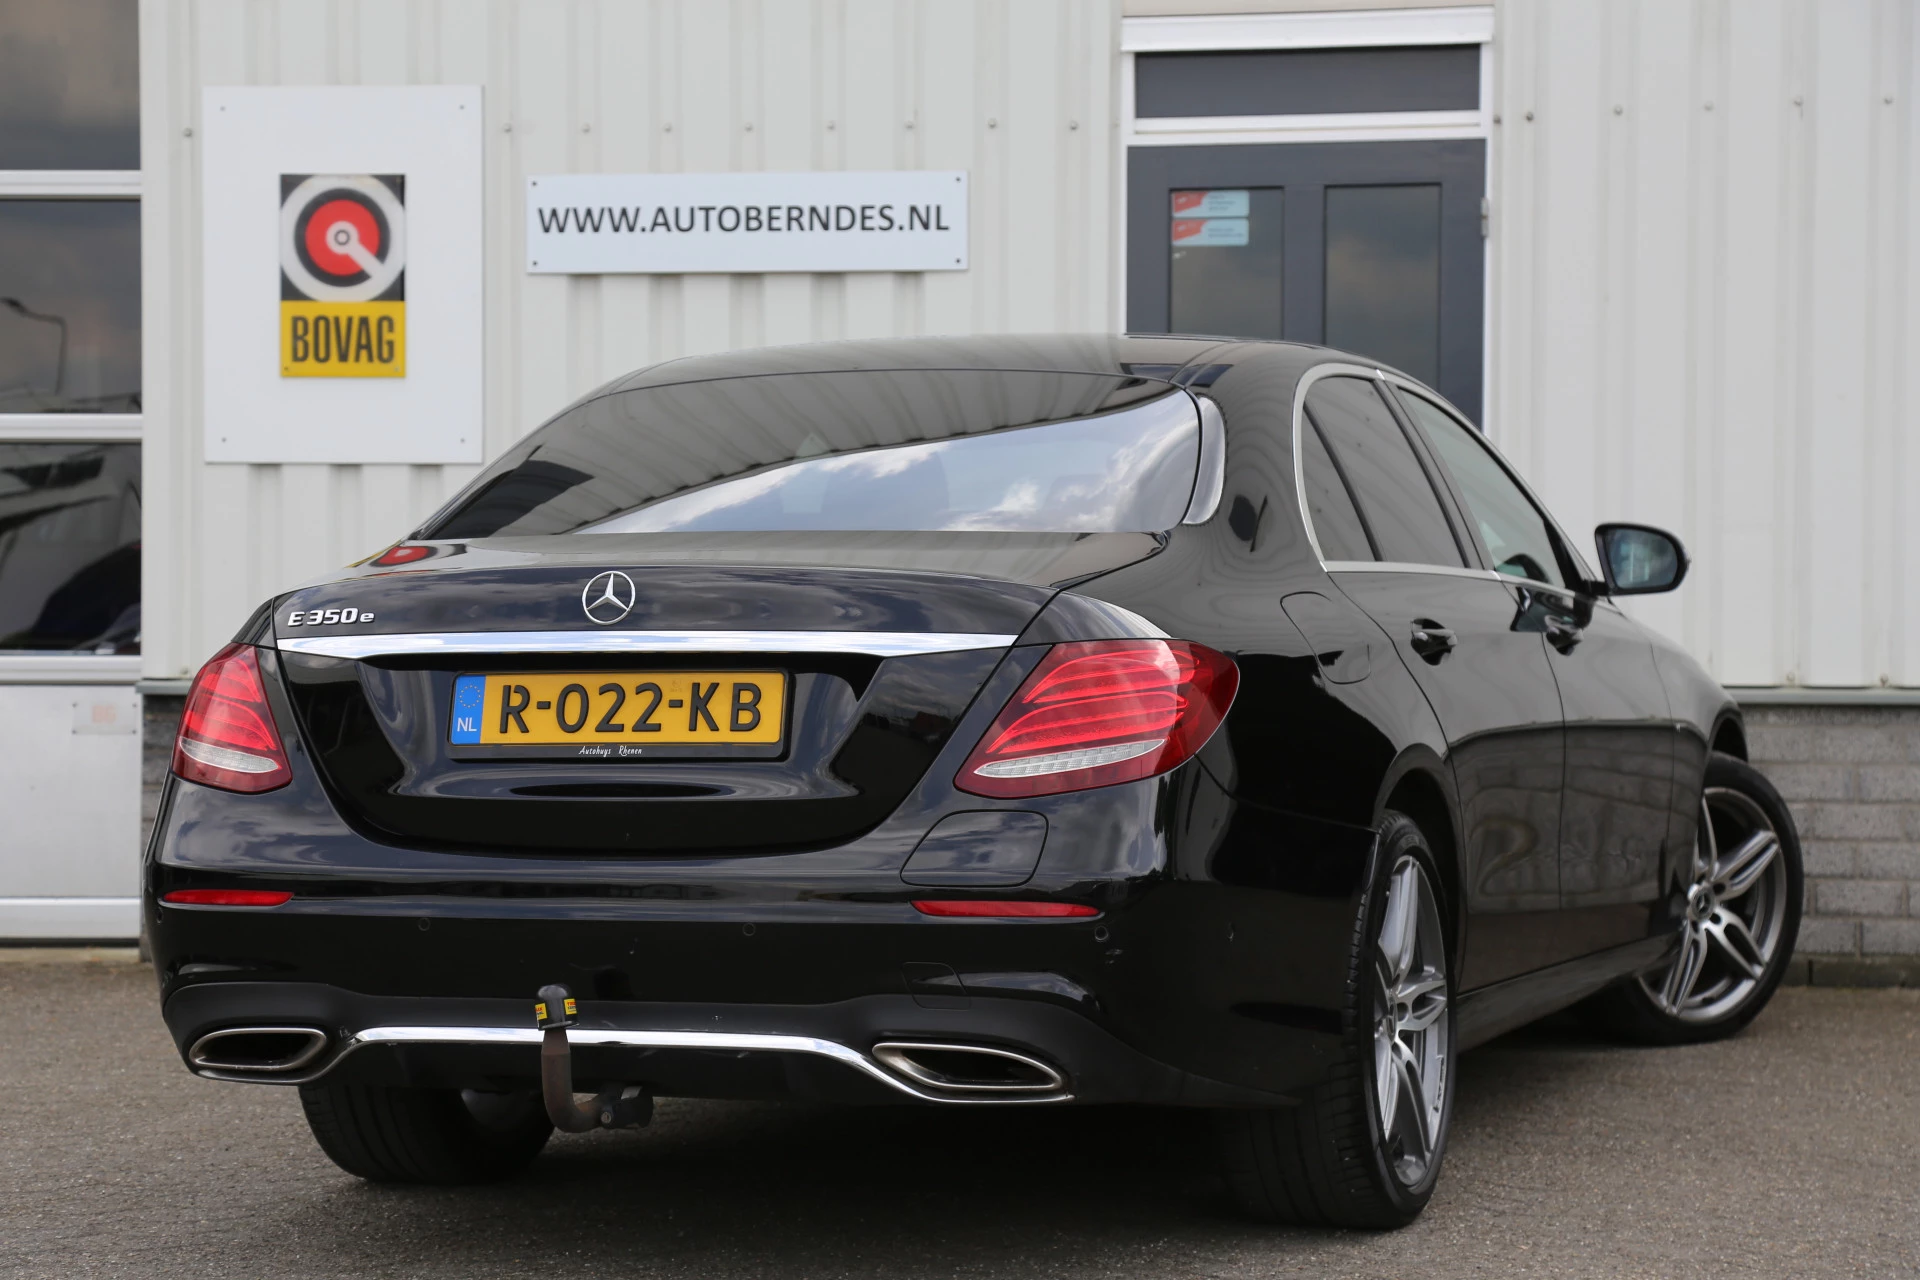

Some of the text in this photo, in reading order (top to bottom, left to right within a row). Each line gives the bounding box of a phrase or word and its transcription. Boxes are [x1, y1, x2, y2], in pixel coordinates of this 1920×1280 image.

[538, 205, 950, 234] WWW.AUTOBERNDES.NL
[291, 314, 395, 364] BOVAG
[499, 682, 762, 734] R-022-KB
[457, 717, 477, 732] NL
[578, 745, 643, 758] Autohuys Rhenen
